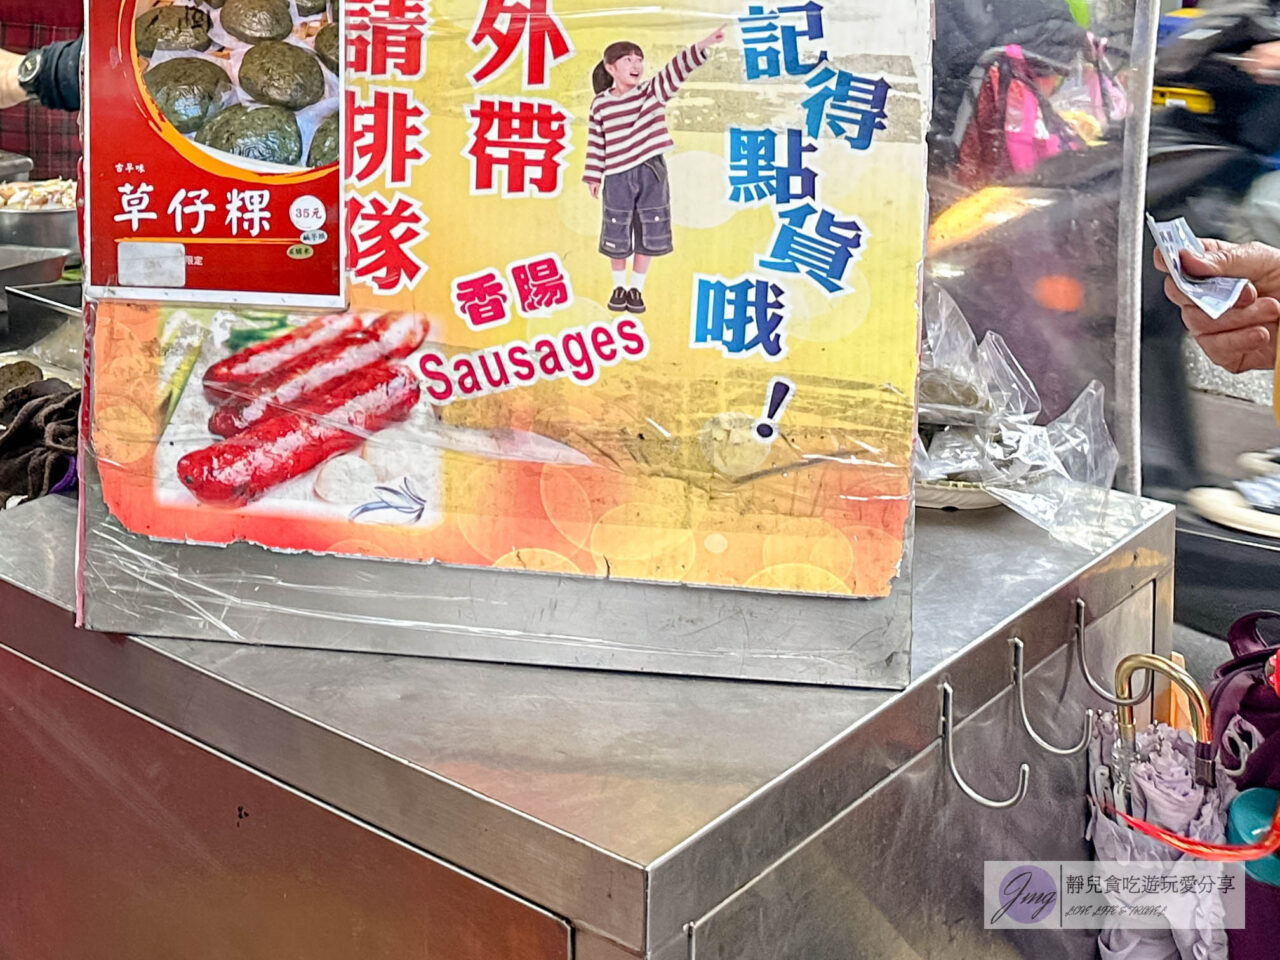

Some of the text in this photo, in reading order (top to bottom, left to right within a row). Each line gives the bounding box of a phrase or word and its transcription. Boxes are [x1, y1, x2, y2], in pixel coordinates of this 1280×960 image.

[113, 182, 272, 237] 草仔粿
[295, 208, 322, 219] 35元
[419, 320, 645, 400] Sausages
